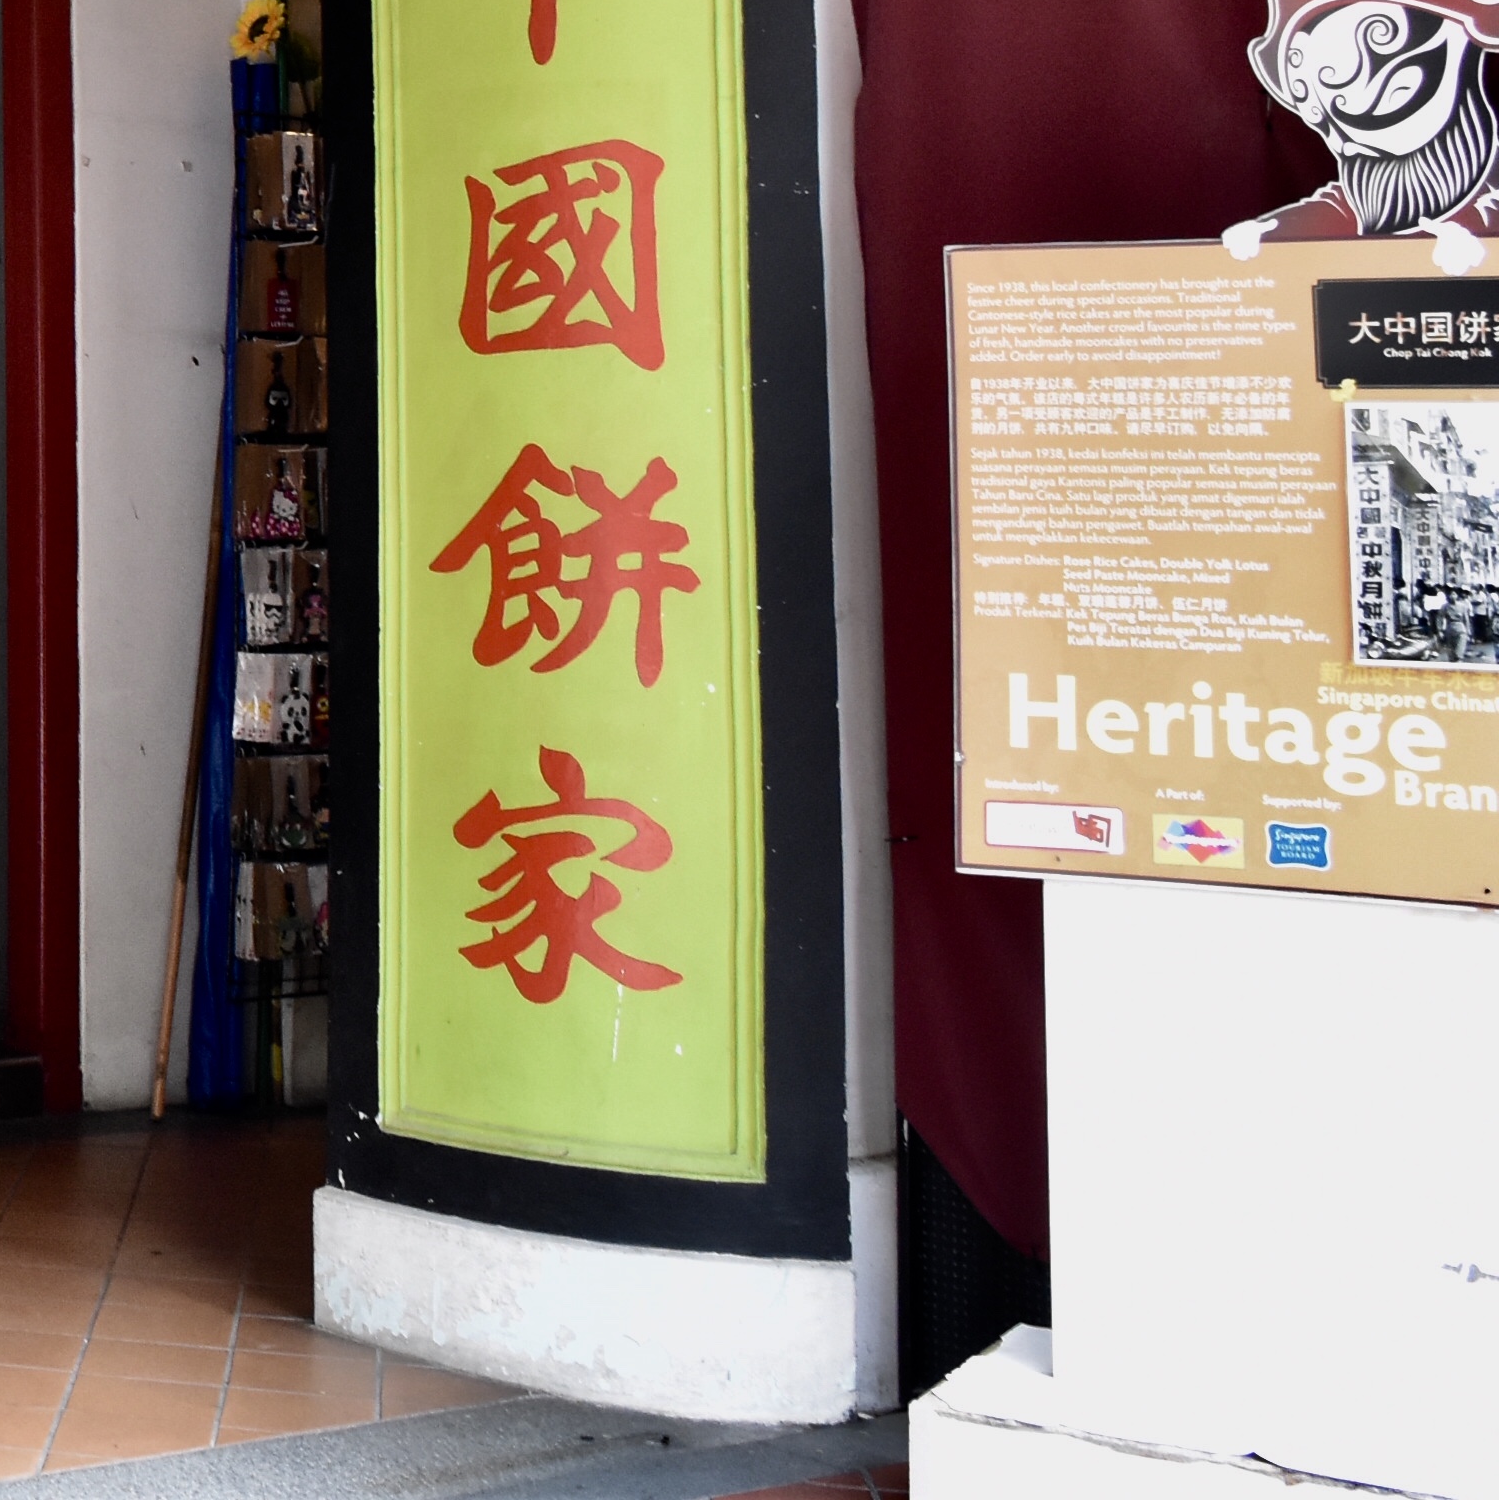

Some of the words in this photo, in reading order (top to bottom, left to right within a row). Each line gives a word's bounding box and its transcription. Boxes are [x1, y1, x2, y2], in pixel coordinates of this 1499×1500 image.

[966, 282, 996, 294] Since
[1030, 282, 1050, 293] this
[1052, 281, 1078, 292] local
[1079, 280, 1157, 295] confectionery
[1159, 279, 1179, 290] has
[1181, 278, 1229, 293] brought
[1231, 278, 1252, 289] out
[1254, 278, 1275, 289] the
[967, 296, 1002, 307] festive
[1004, 295, 1035, 306] cheer
[1037, 294, 1074, 309] during
[1076, 294, 1115, 308] special
[1177, 292, 1241, 304] Traditional
[967, 309, 1054, 323] Cantonese-style
[1056, 309, 1077, 320] rice
[1079, 308, 1110, 319] cakes
[1112, 311, 1131, 319] are
[1133, 308, 1152, 319] the
[1154, 307, 1183, 319] most
[1185, 307, 1232, 321] popular
[1234, 306, 1275, 320] during
[968, 323, 999, 334] Lunar
[1000, 323, 1027, 334] New
[1029, 323, 1057, 334] Year.
[1059, 322, 1106, 333] Another
[1107, 322, 1145, 333] crowd
[1146, 322, 1199, 333] favourite
[1212, 321, 1232, 332] the
[1234, 321, 1260, 332] nine
[1262, 321, 1296, 335] types
[969, 337, 980, 347] of
[1014, 336, 1073, 347] handmade
[1075, 336, 1138, 347] mooncakes
[1140, 336, 1165, 347] with
[1167, 338, 1183, 346] no
[1185, 335, 1263, 349] preservatives
[1009, 350, 1044, 361] Order
[1046, 350, 1074, 364] early
[1076, 350, 1089, 361] to
[1091, 350, 1123, 361] avoid
[1125, 350, 1222, 363] disappointment!
[1383, 348, 1413, 360] Chop
[1416, 348, 1431, 357] Tai
[1433, 348, 1469, 360] Chong
[1470, 348, 1493, 357] Kok
[970, 447, 998, 461] Sejak
[1000, 447, 1034, 458] tahun
[1068, 448, 1099, 459] kedai
[1198, 449, 1262, 460] membantu
[1264, 449, 1321, 463] mencipta
[1014, 465, 1066, 476] perayaan
[1110, 463, 1147, 474] musim
[1233, 463, 1277, 477] tepung
[1279, 464, 1313, 475] beras
[1108, 477, 1144, 490] paling
[1146, 477, 1193, 491] popular
[1239, 478, 1278, 489] musim
[1280, 481, 1336, 493] perayaan
[972, 489, 1006, 500] Tahun
[1008, 489, 1034, 500] Baru
[1066, 490, 1091, 501] Satu
[1115, 490, 1158, 504] produk
[1160, 494, 1188, 505] yang
[1190, 491, 1220, 502] amat
[1075, 504, 1107, 516] bulan
[1109, 508, 1137, 519] yang
[1139, 505, 1177, 517] dibuat
[1179, 506, 1224, 520] dengan
[1226, 506, 1267, 521] tangan
[1268, 507, 1293, 518] dan
[1294, 507, 1326, 519] tidak
[1048, 518, 1083, 529] bahan
[1192, 520, 1252, 534] tempahan
[973, 554, 1022, 568] Signature
[1063, 556, 1091, 567] Rose
[1093, 556, 1118, 568] Rice
[1160, 558, 1204, 569] Double
[1235, 559, 1269, 571] Lotus
[1063, 568, 1091, 580] Seed
[1092, 582, 1152, 593] Mooncake
[973, 604, 1013, 617] Produk
[1317, 686, 1427, 712] Singapore
[1008, 672, 1446, 796] Heritage
[1155, 787, 1164, 798] A
